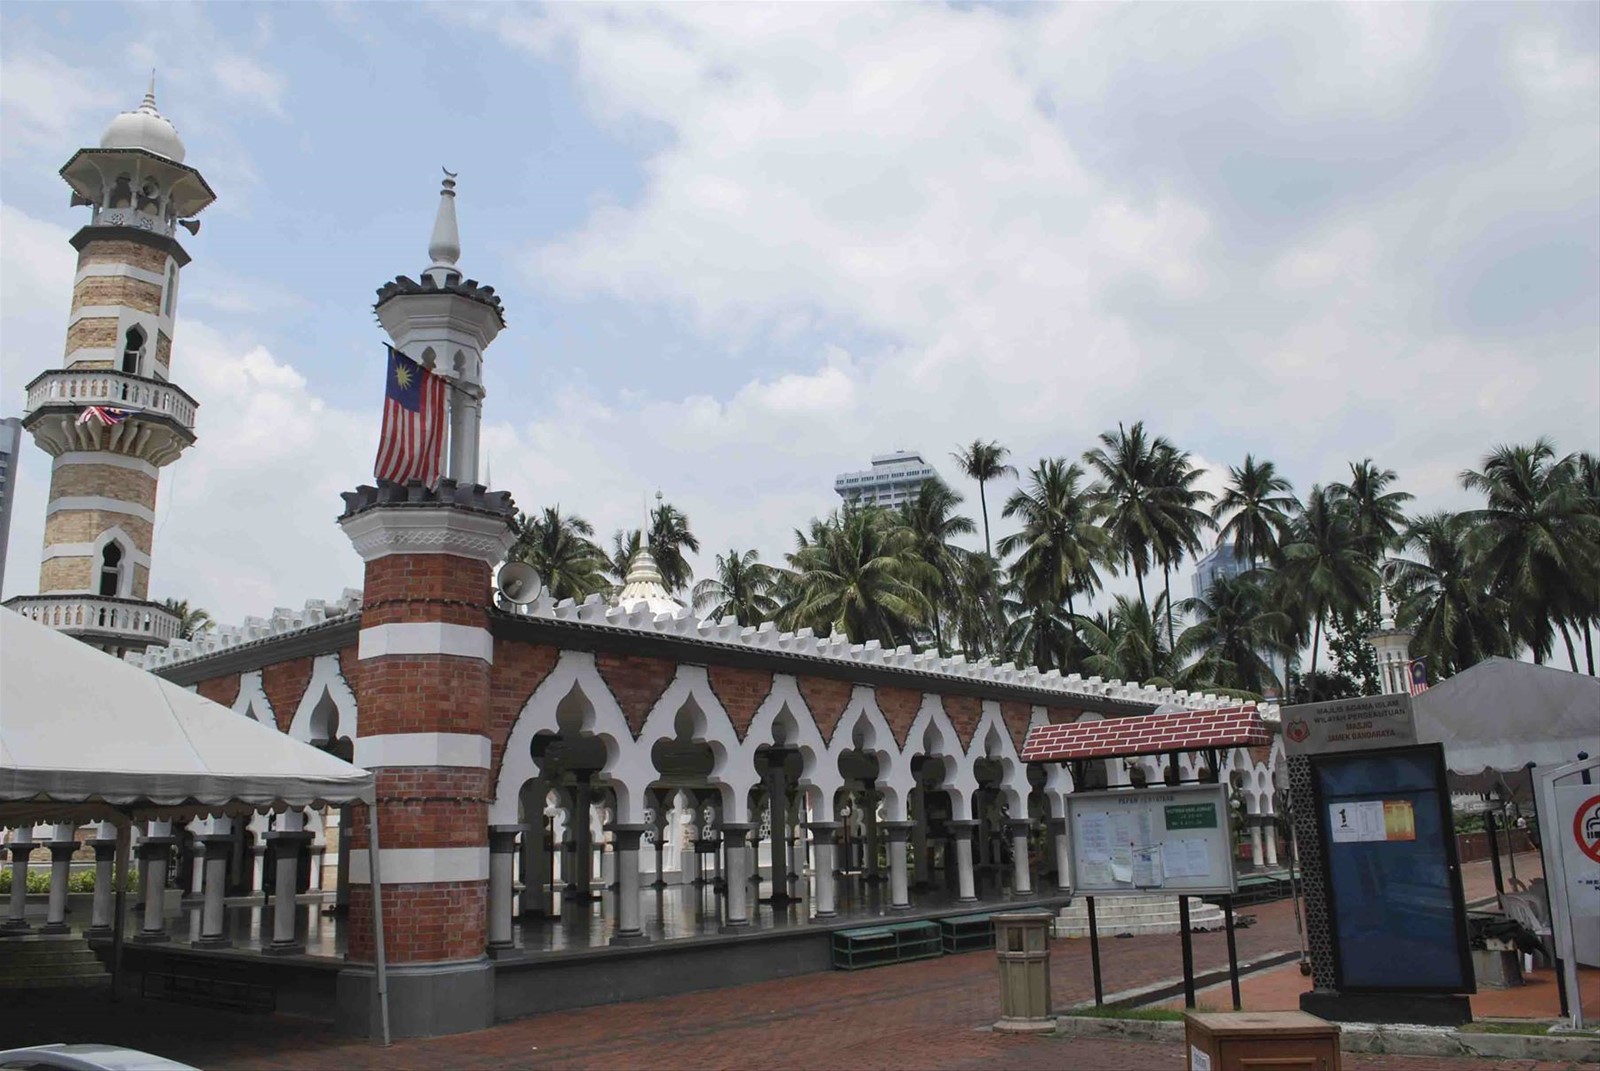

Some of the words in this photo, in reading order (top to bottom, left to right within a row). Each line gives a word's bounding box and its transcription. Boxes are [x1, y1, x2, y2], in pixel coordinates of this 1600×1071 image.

[1316, 705, 1343, 714] MAJLIS
[1345, 702, 1373, 713] AGAMA
[1375, 700, 1399, 710] ISLAM
[1314, 714, 1346, 724] WILAYAH
[1347, 709, 1406, 721] PERSEKUTUAN
[1345, 721, 1373, 731] MASJID
[1328, 733, 1350, 742] JAMEK
[1352, 729, 1396, 741] BANDARAYA
